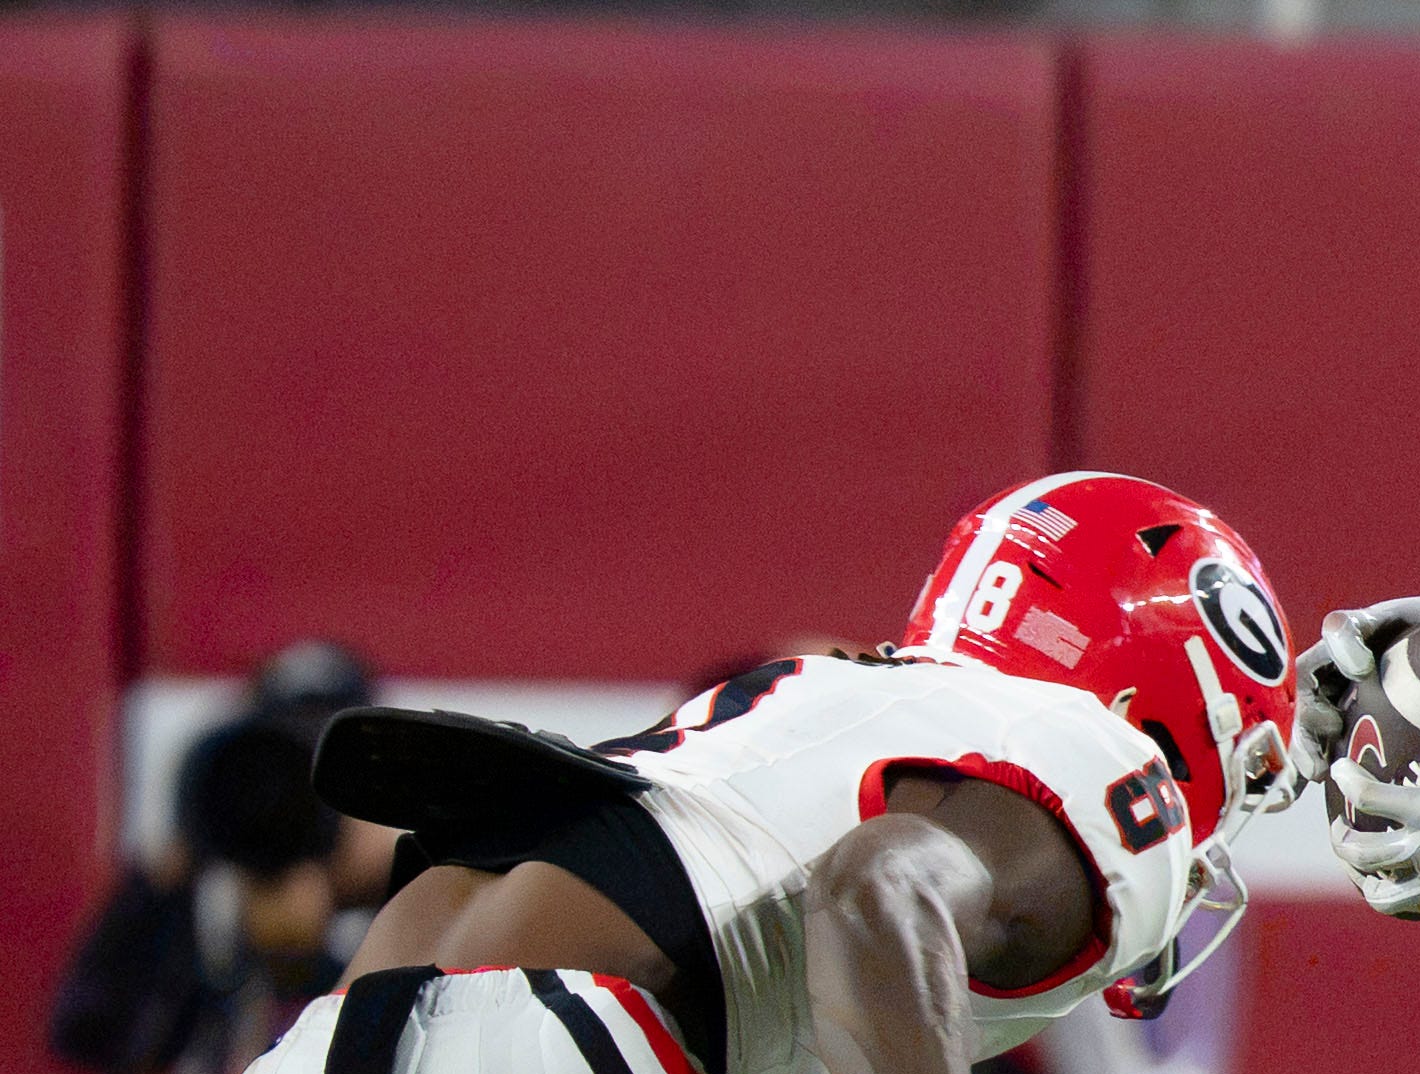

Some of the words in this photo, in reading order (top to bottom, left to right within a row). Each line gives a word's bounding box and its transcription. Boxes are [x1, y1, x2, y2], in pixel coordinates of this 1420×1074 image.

[965, 560, 1023, 633] 8
[1196, 562, 1286, 681] G
[1104, 756, 1184, 855] 8
